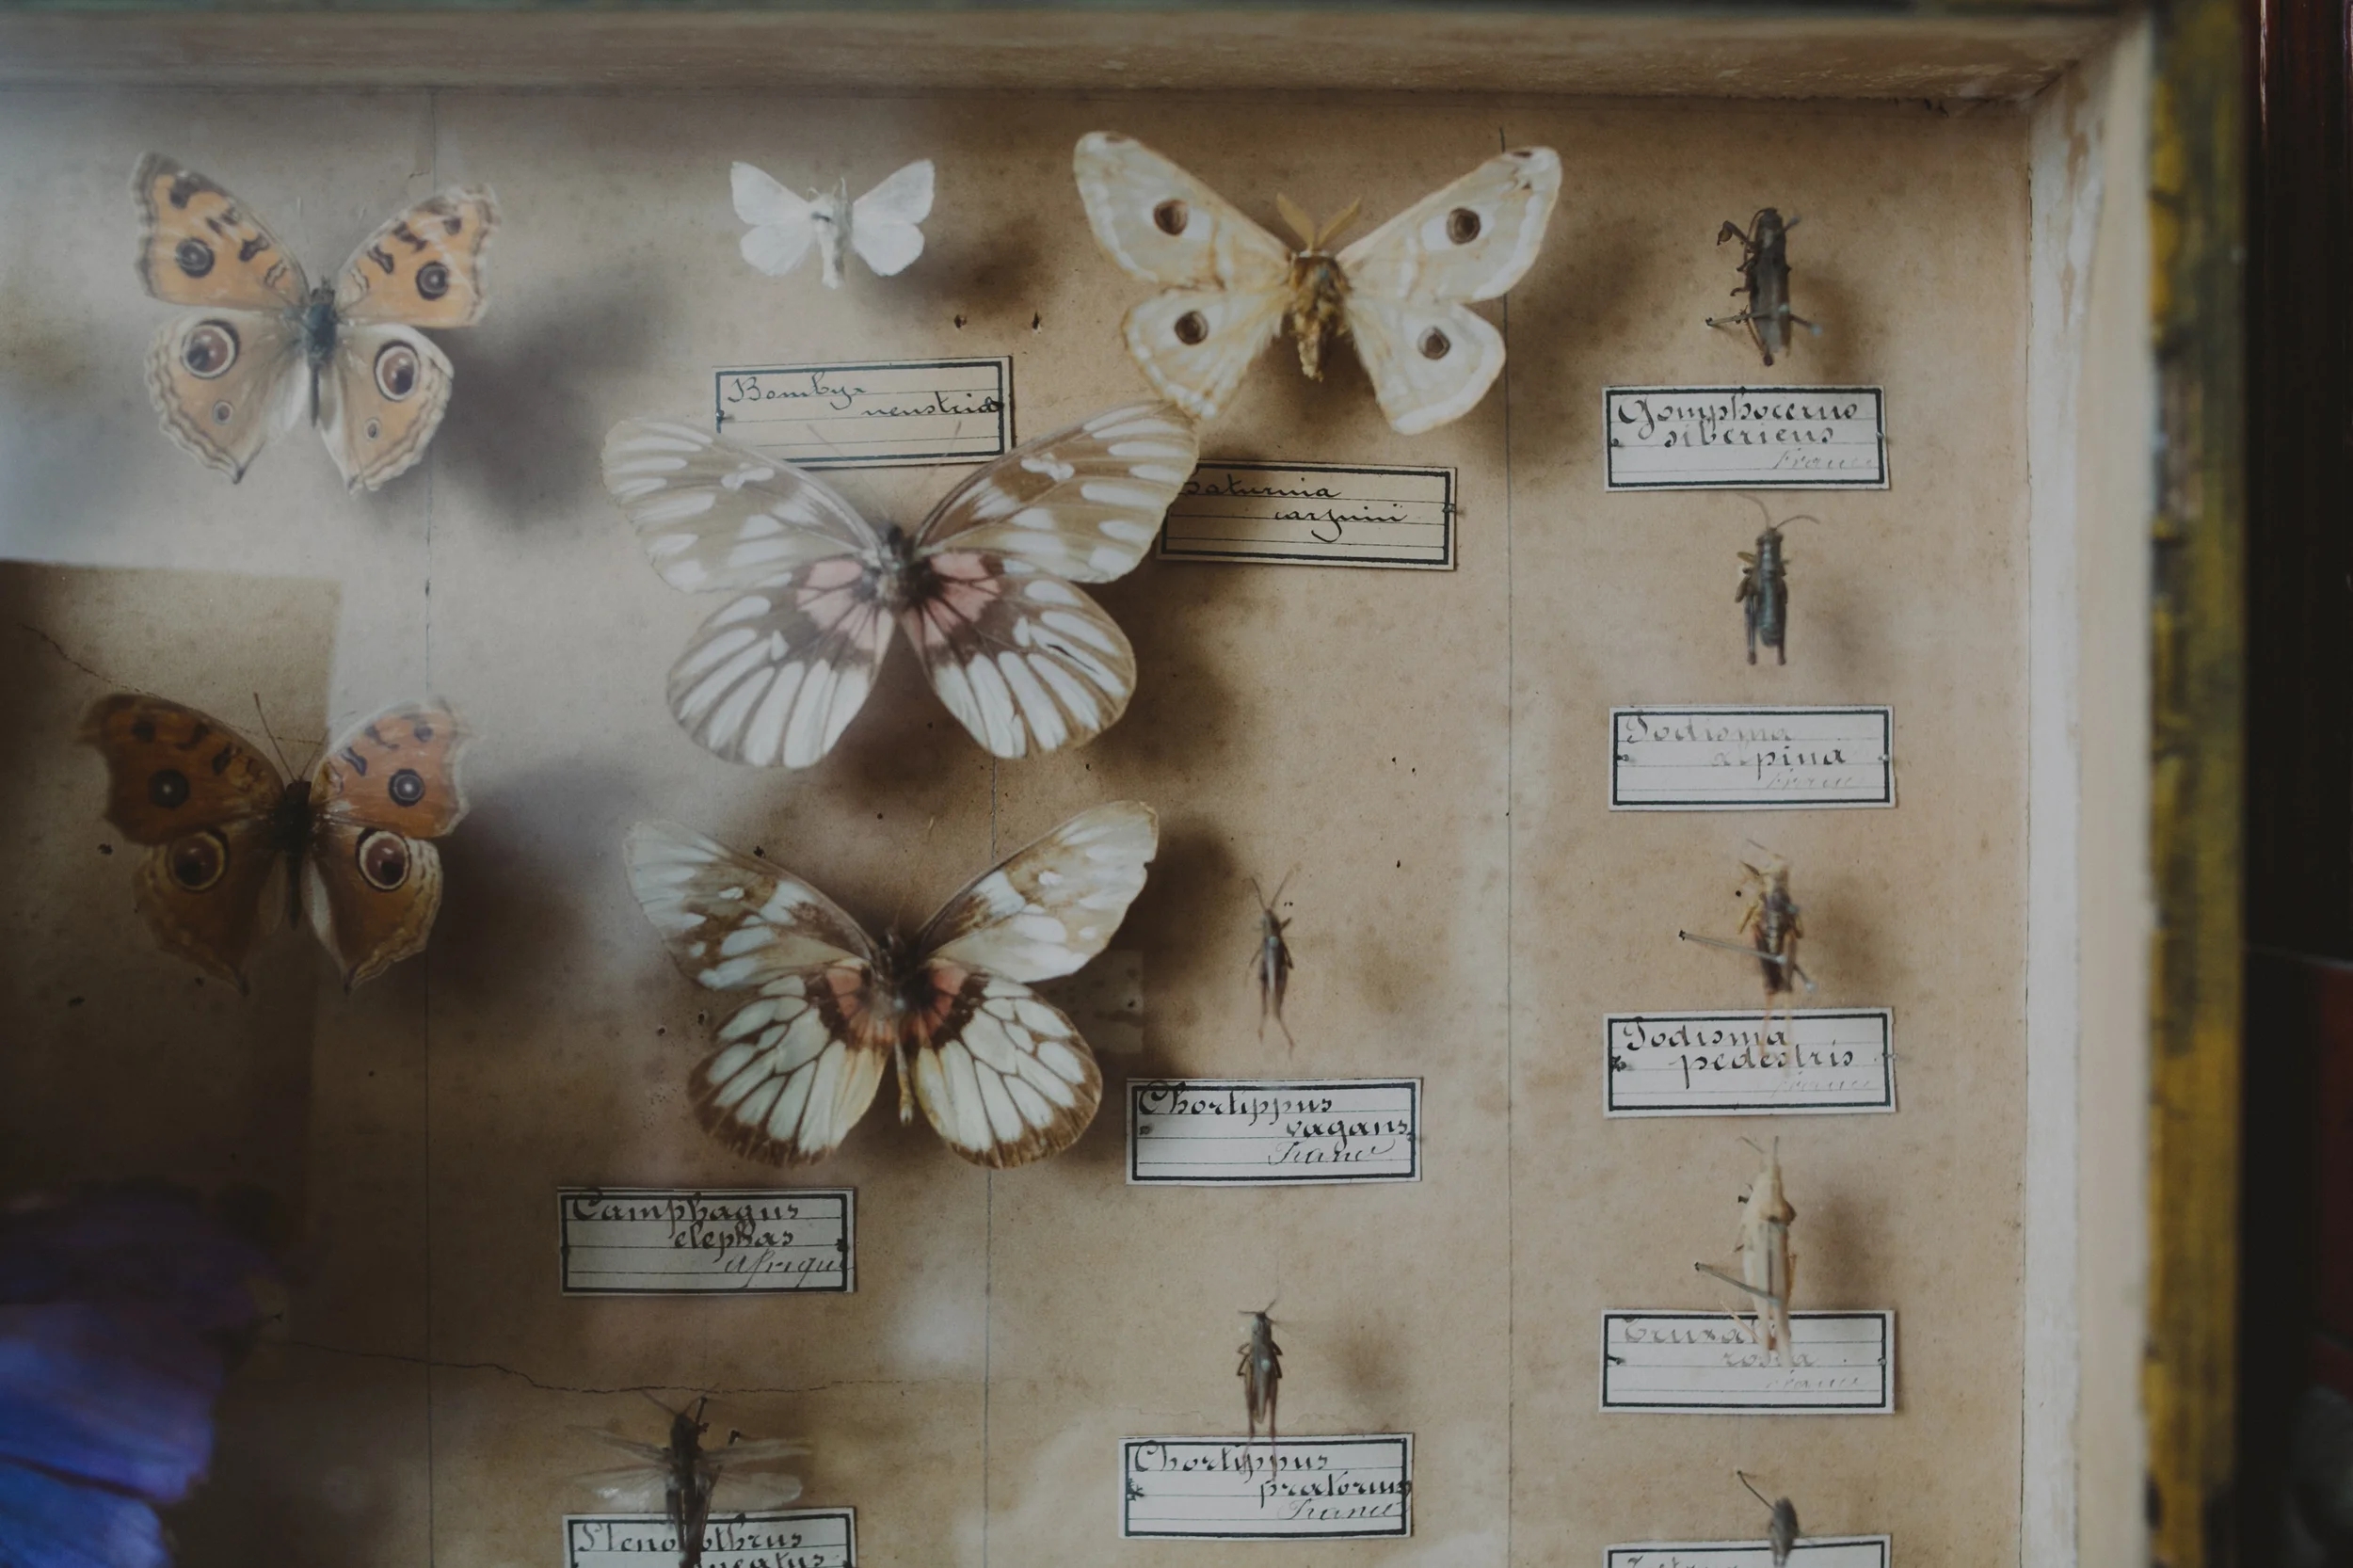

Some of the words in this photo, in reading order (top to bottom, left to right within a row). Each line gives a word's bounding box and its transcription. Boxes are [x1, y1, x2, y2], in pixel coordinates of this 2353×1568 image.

[728, 371, 867, 410] Bombyx
[1623, 1016, 1788, 1051] Podisma
[1138, 1080, 1333, 1127] Chortippus
[1286, 1118, 1409, 1150] vagans
